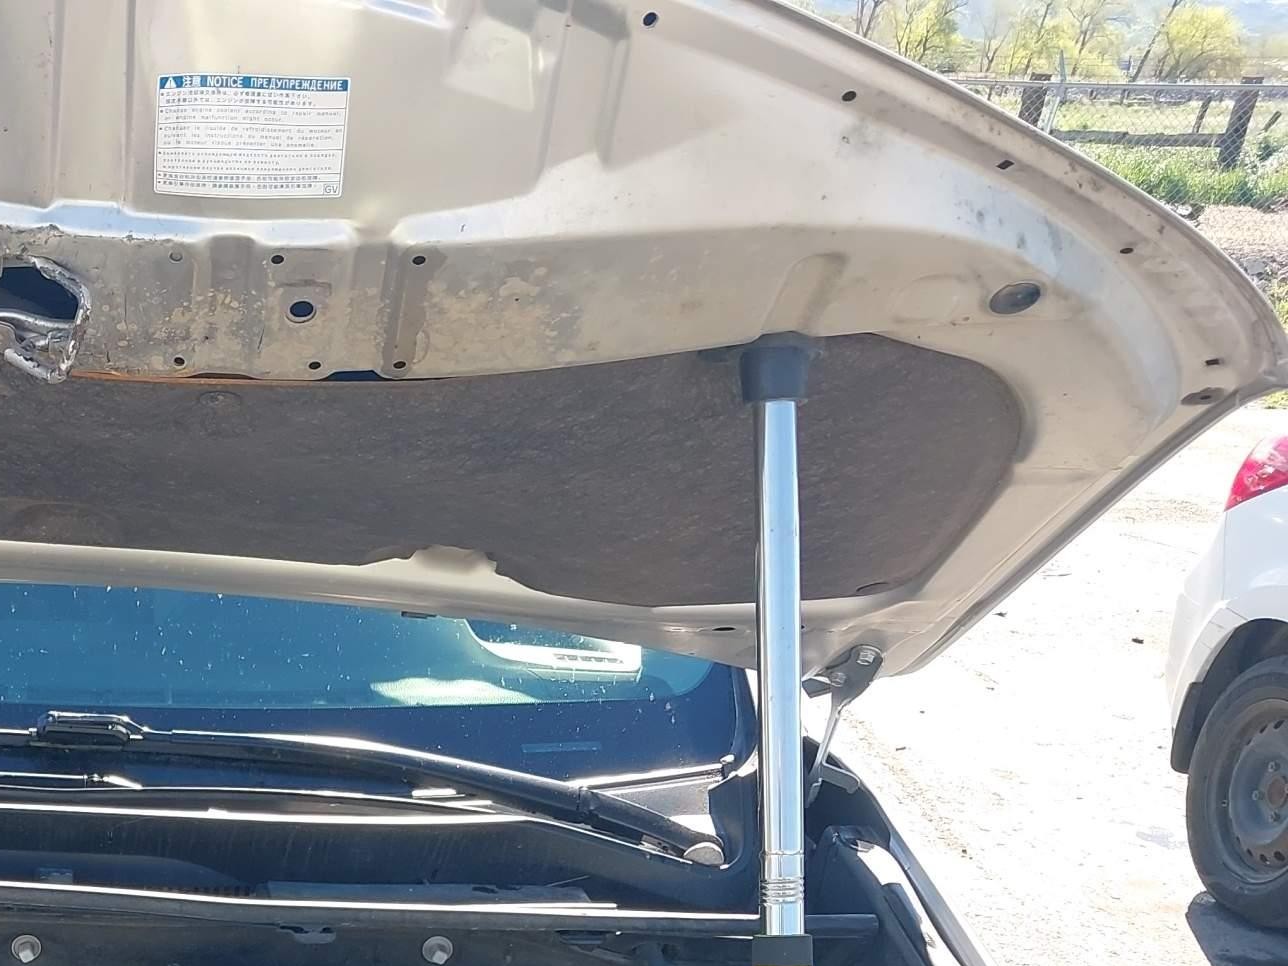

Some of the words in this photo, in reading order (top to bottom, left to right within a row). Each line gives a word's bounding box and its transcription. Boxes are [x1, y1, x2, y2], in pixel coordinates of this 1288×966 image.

[183, 76, 201, 88] 注意
[207, 76, 244, 88] NOTICE
[250, 77, 344, 91] ПРЕДУПРЕЖДЕНИЕ
[324, 185, 339, 194] GV
